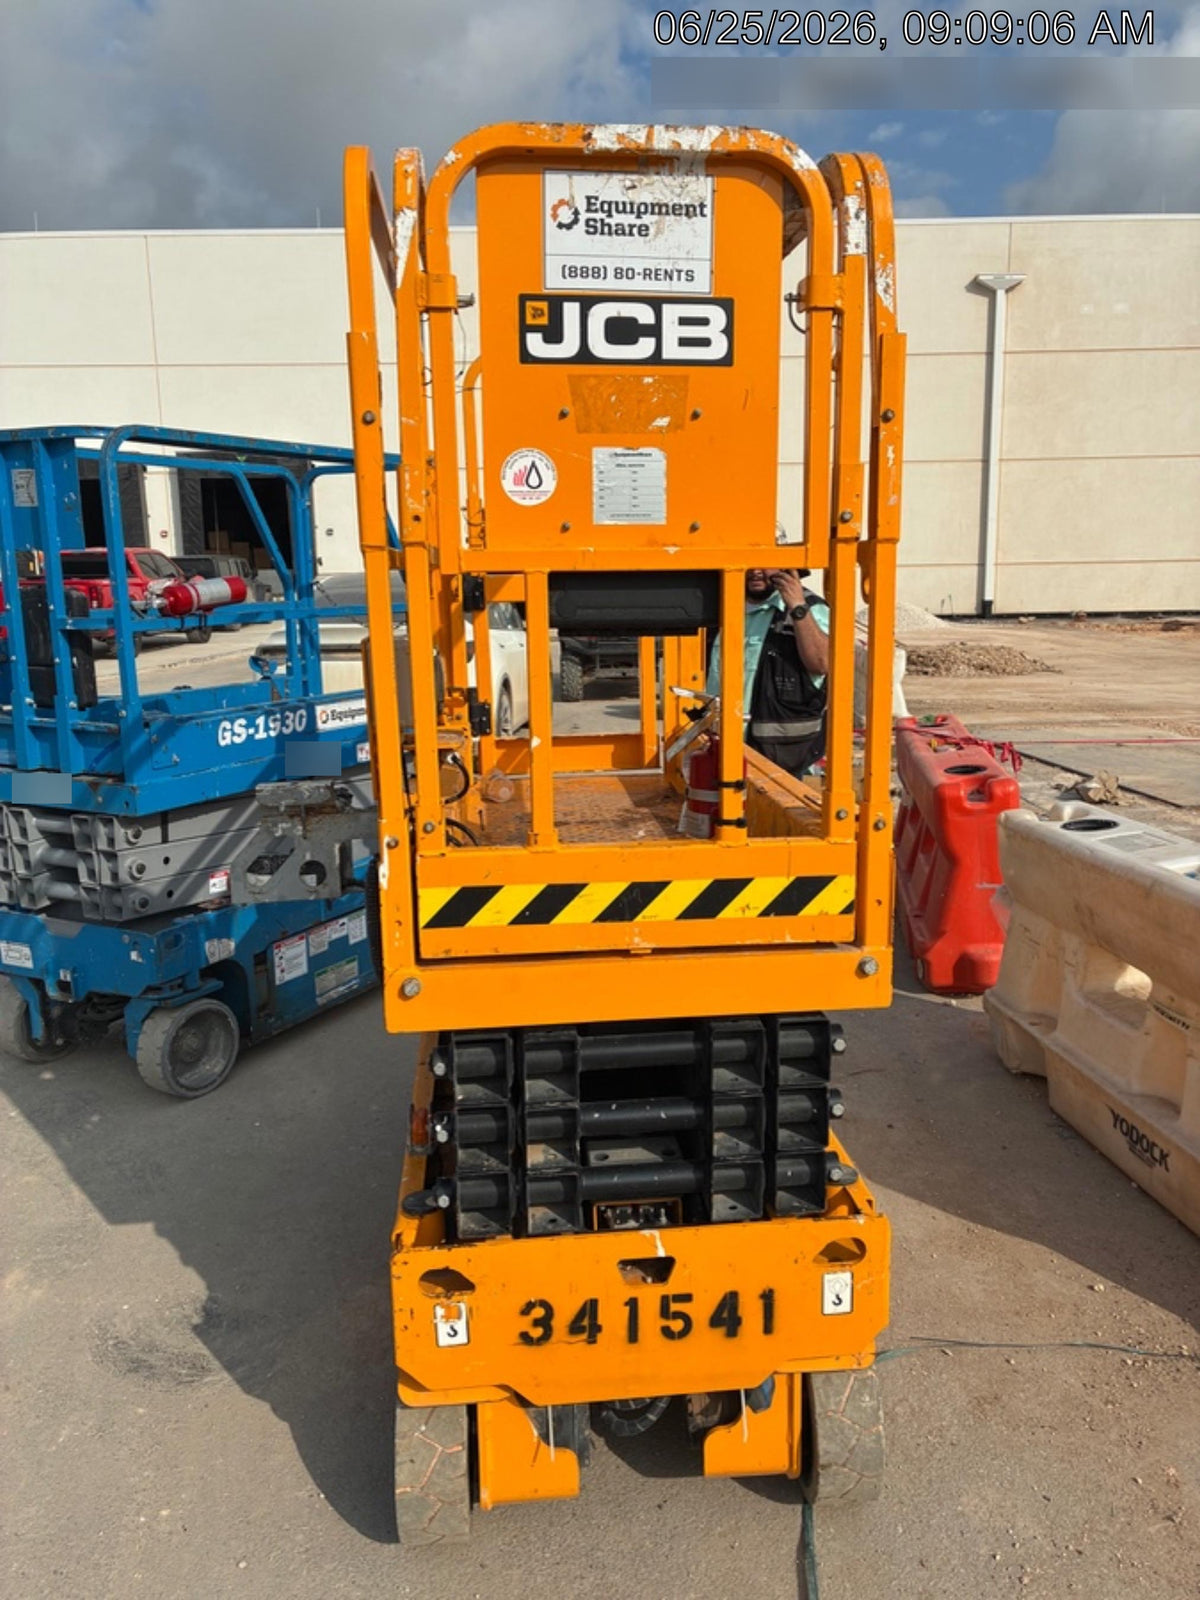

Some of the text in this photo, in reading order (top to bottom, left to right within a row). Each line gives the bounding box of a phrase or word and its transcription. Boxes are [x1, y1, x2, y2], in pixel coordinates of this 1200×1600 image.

[584, 195, 708, 218] Equipment
[584, 218, 651, 237] Share
[561, 264, 696, 282] (888) 80-RENTS
[525, 301, 729, 360] JCB
[217, 708, 308, 748] GS-1930
[1105, 1103, 1170, 1173] YODOCK
[518, 1287, 776, 1346] 341541
